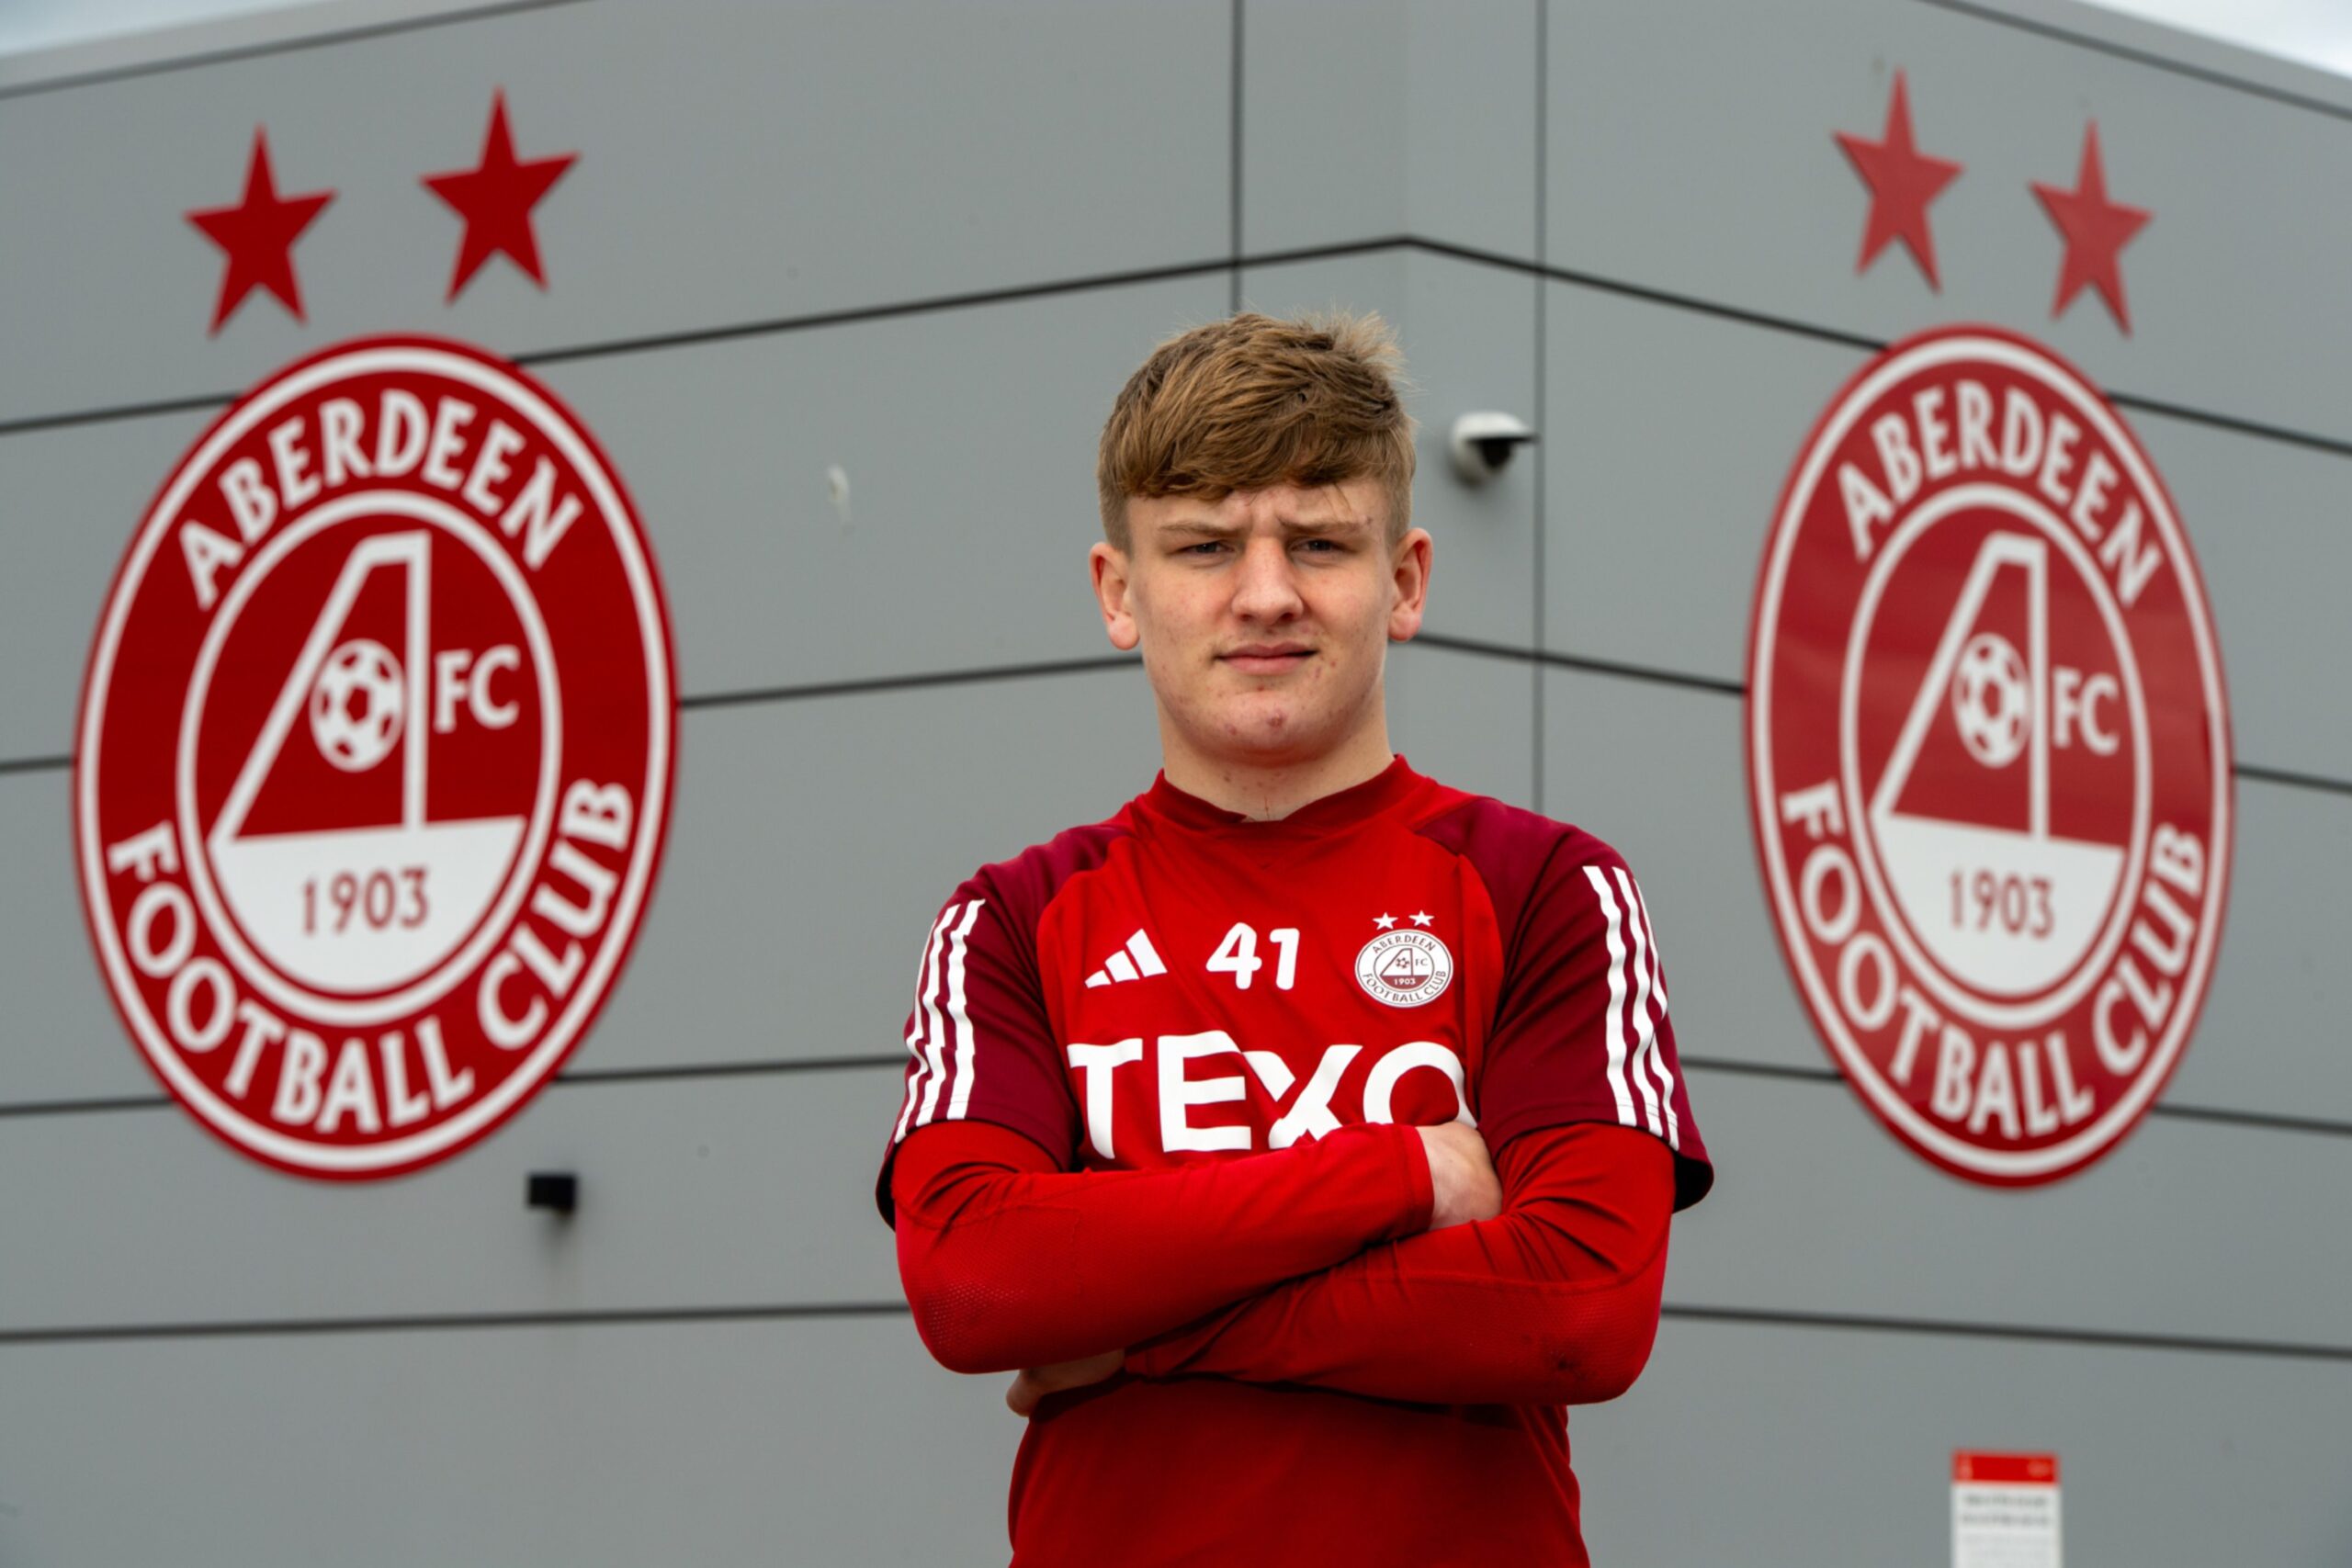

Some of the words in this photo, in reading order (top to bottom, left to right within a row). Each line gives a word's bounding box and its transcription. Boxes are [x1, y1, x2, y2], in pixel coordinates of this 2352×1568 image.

[180, 389, 584, 611] ABERDEEN
[1838, 379, 2162, 608] ABERDEEN
[301, 866, 430, 938] 1903
[1373, 934, 1436, 954] ABERDEEN
[1948, 867, 2054, 939] 1903
[108, 820, 474, 1134] FOOTBALL
[477, 778, 634, 1050] CLUB
[1205, 921, 1300, 990] 41
[1363, 972, 1423, 1003] FOOTBALL
[1423, 970, 1446, 996] CLUB
[1781, 778, 2093, 1139] FOOTBALL
[2092, 823, 2206, 1076] CLUB
[1066, 1030, 1478, 1160] TEXO
